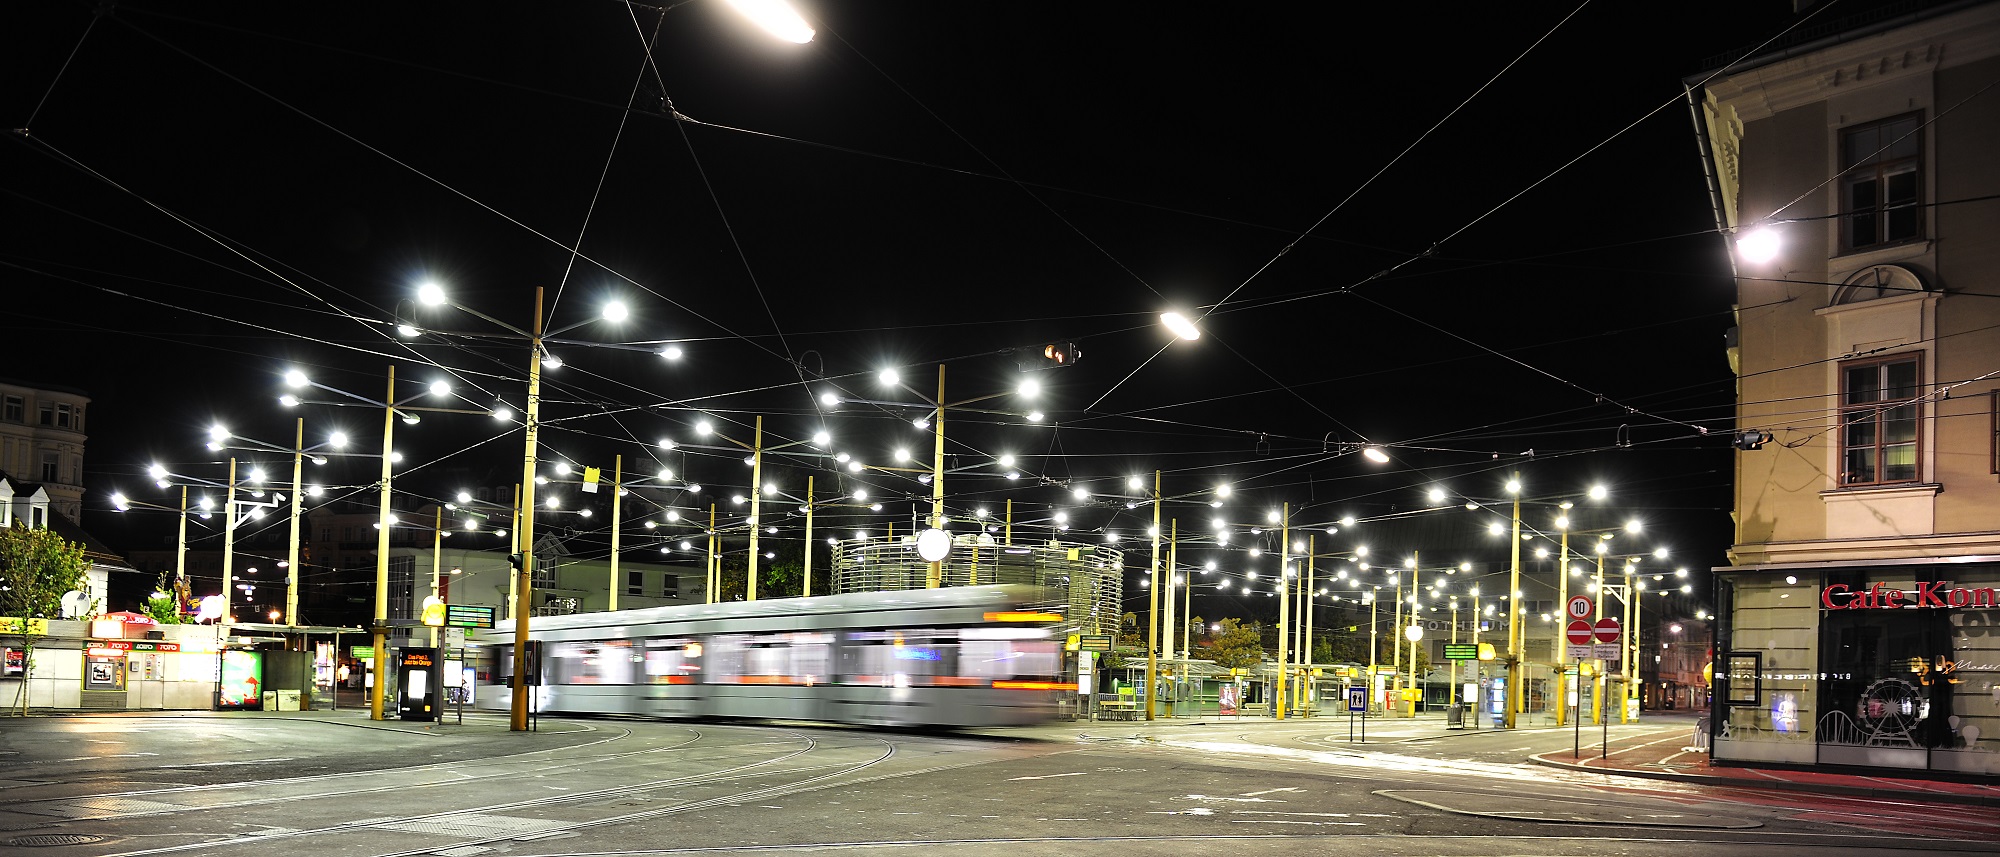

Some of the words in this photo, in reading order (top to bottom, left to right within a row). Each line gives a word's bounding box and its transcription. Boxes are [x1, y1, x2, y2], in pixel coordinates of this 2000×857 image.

[1821, 581, 1904, 609] Cafe
[1915, 581, 2000, 609] Kon
[1574, 601, 1585, 615] 10
